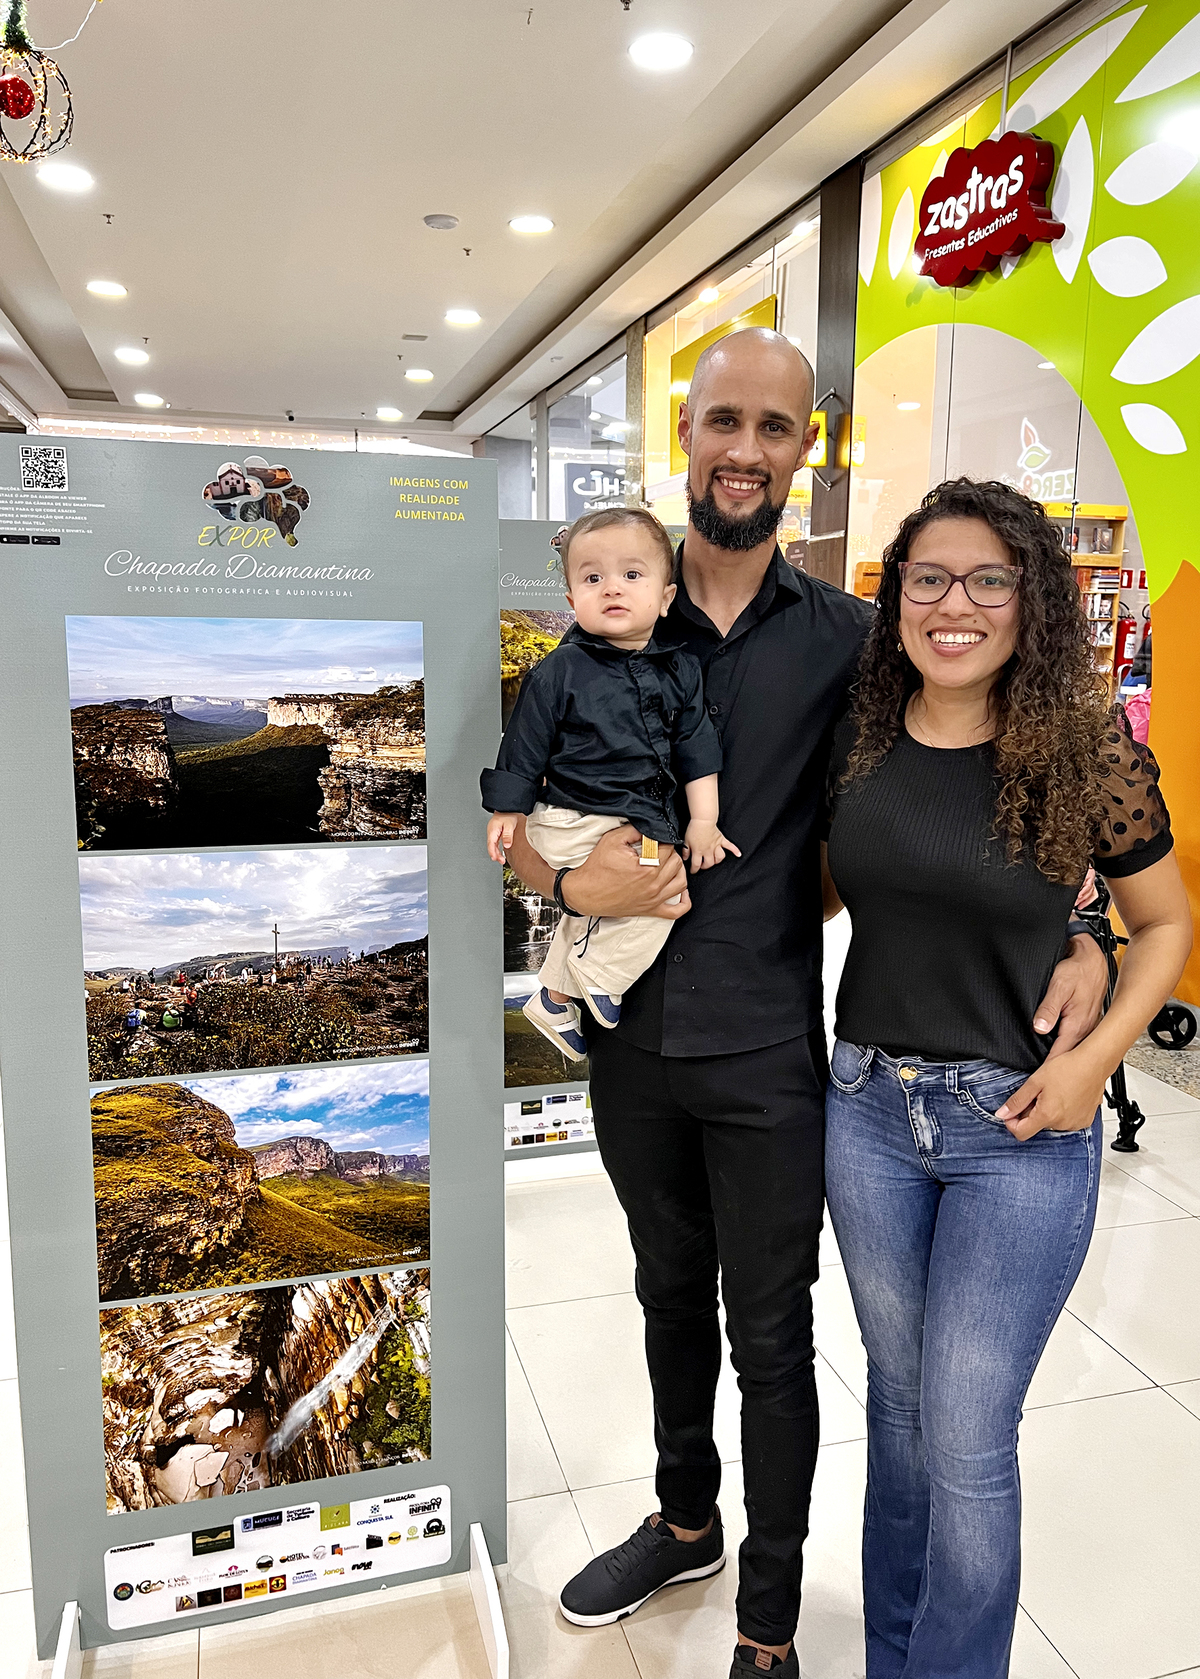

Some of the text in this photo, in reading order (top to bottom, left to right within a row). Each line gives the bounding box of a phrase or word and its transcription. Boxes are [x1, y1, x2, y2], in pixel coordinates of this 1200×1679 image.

[924, 154, 1024, 236] zastras
[967, 208, 1018, 246] Educativos
[390, 476, 468, 489] IMAGENS COM
[400, 493, 460, 505] REALIDADE
[394, 509, 466, 521] AUMENTADA
[198, 525, 276, 548] EXPOR
[104, 549, 375, 582] Chapada Diamantina
[500, 572, 558, 590] Chapada
[127, 585, 190, 593] EXPOSIÇÃO
[195, 587, 270, 595] FOTOGRAFICA
[409, 1502, 440, 1514] INFINITY
